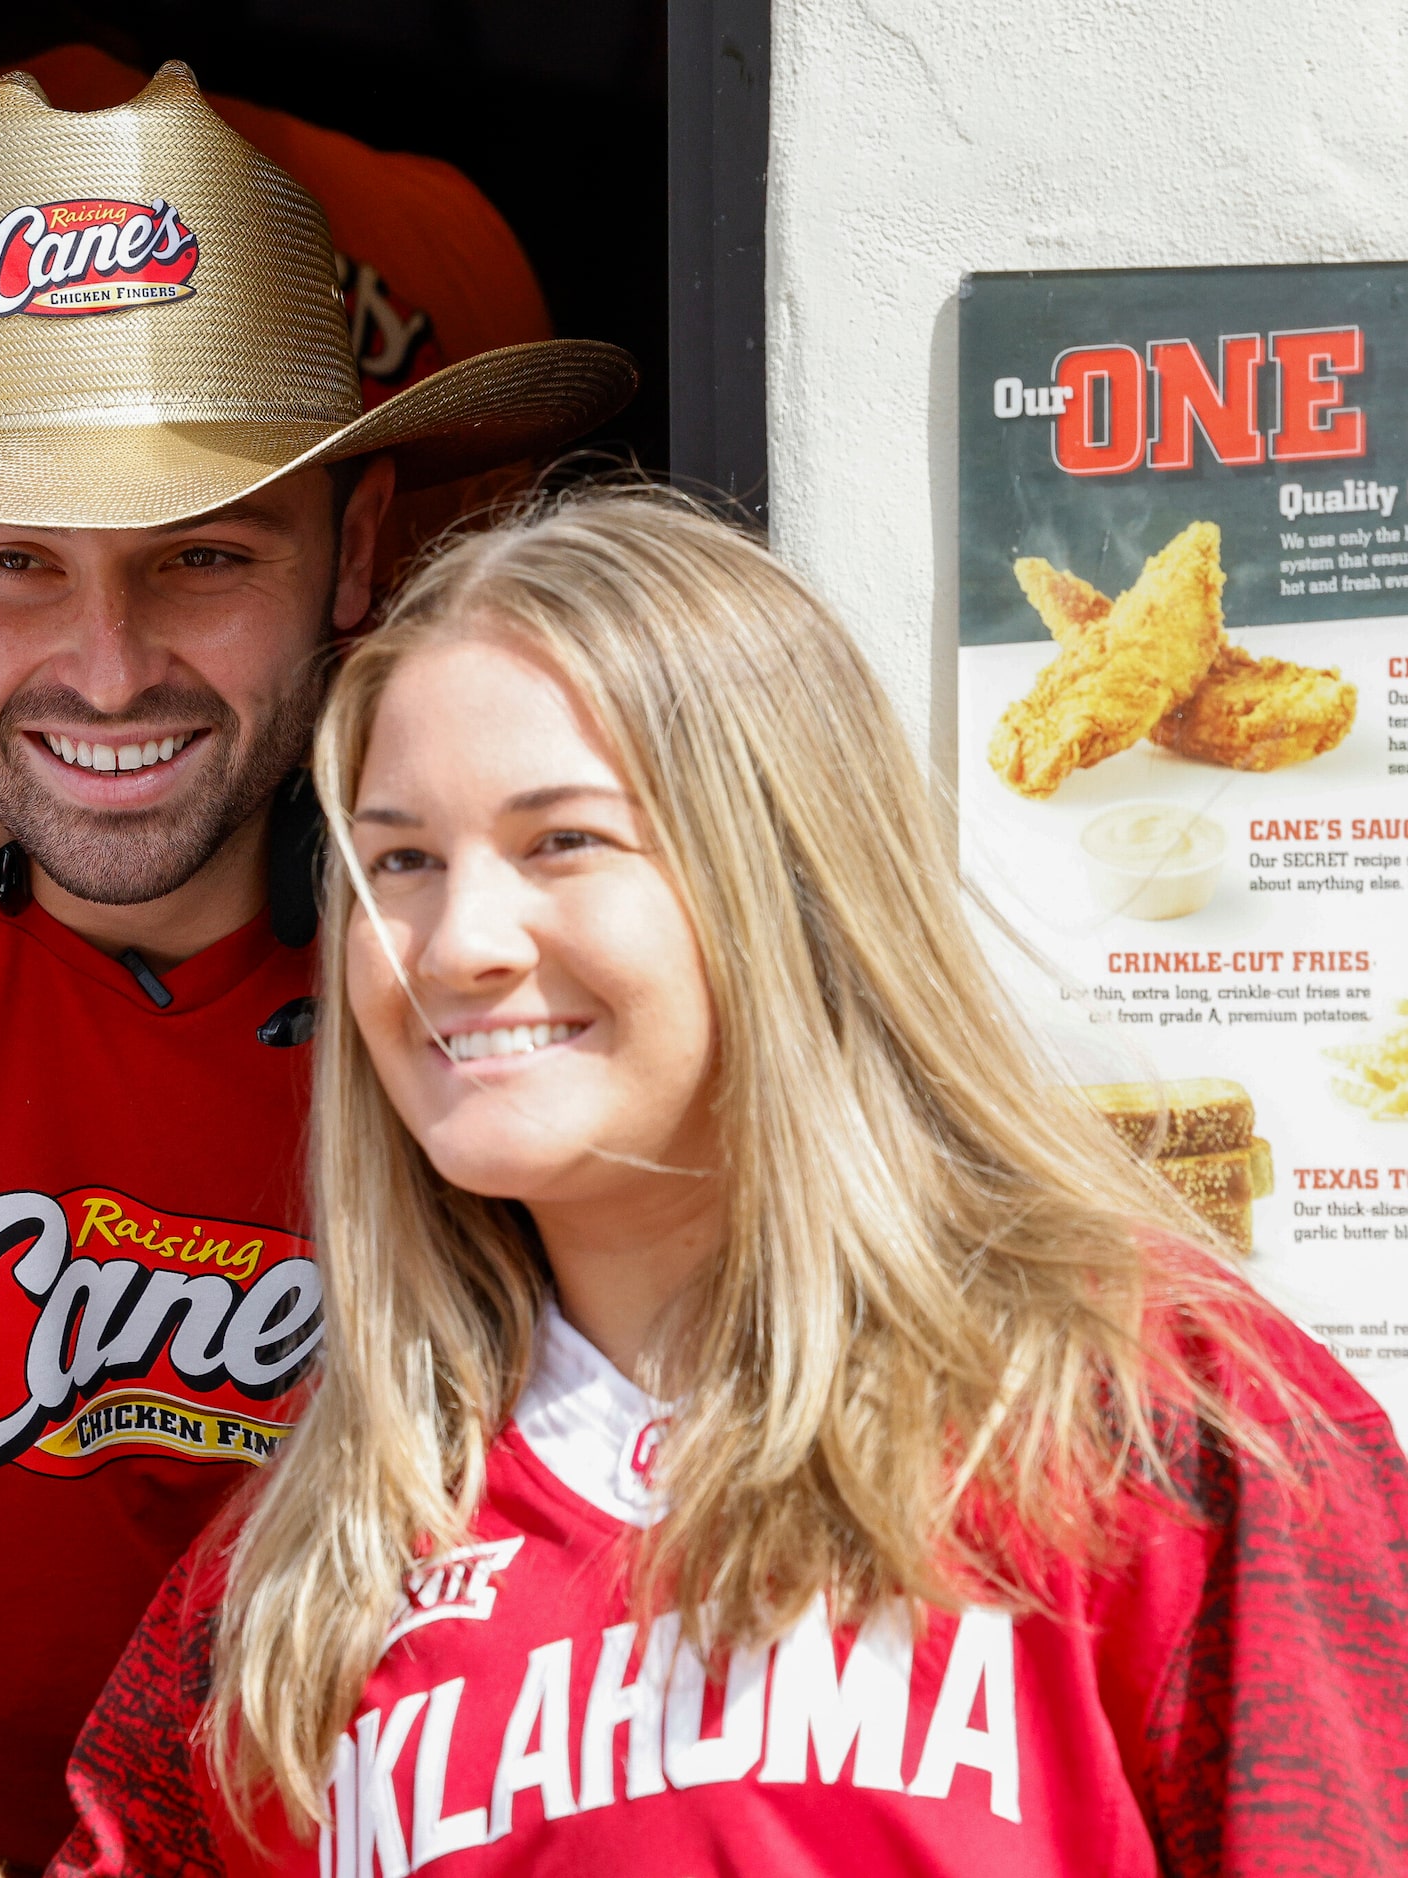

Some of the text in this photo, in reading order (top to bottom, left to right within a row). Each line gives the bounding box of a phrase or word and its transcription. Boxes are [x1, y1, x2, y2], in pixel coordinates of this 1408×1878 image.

[50, 204, 128, 229] Raising
[993, 325, 1367, 477] Our ONE
[1279, 479, 1399, 521] Quality
[1279, 526, 1401, 550] We use only the
[1279, 556, 1335, 576] system
[1337, 551, 1369, 569] that
[1280, 579, 1306, 596] hot
[1308, 575, 1338, 594] and
[1341, 572, 1382, 592] fresh
[1250, 819, 1342, 841] CANE'S
[1249, 852, 1402, 870] Our SECRET recipe
[1249, 874, 1405, 894] about anything else.
[1108, 951, 1370, 973] CRINKLE-CUT FRIES
[1093, 985, 1126, 1002] thin,
[1132, 987, 1170, 1000] extra
[1176, 984, 1212, 1003] long,
[1217, 984, 1301, 1000] crinkle-cut
[1306, 984, 1341, 999] fries
[1346, 987, 1371, 999] are
[1118, 1008, 1154, 1024] from
[1159, 1008, 1203, 1027] grade
[1228, 1009, 1297, 1025] premium
[1293, 1168, 1379, 1190] TEXAS
[1294, 1201, 1322, 1217] Our
[76, 1197, 264, 1280] Raising
[1294, 1224, 1338, 1243] garlic
[1343, 1224, 1389, 1240] butter
[1359, 1320, 1388, 1335] and
[1345, 1346, 1373, 1359] our
